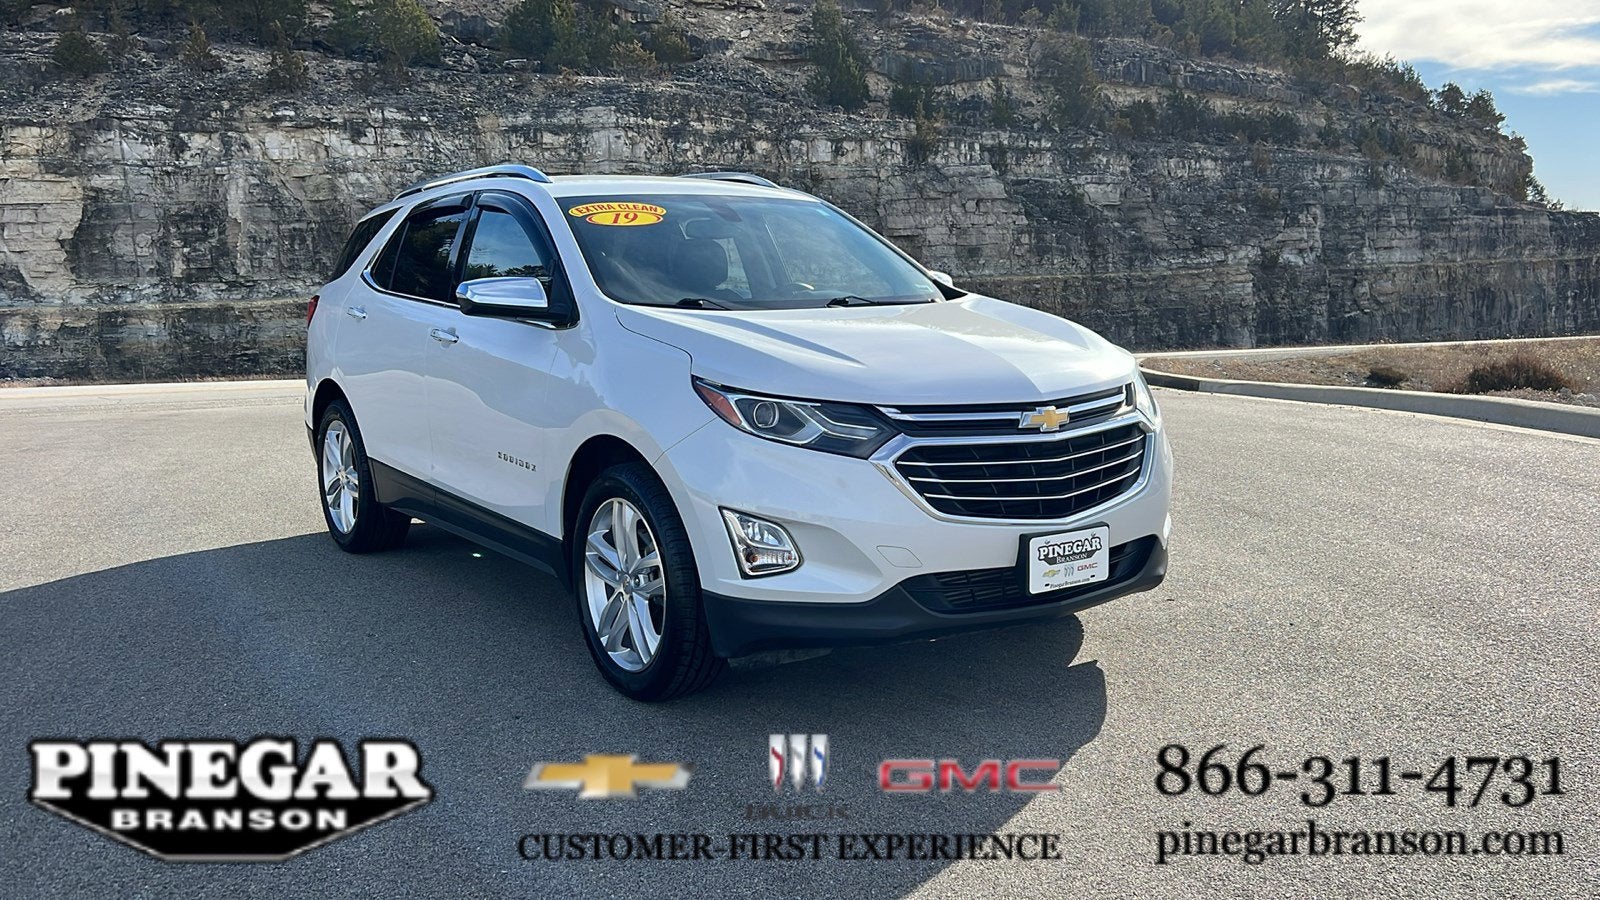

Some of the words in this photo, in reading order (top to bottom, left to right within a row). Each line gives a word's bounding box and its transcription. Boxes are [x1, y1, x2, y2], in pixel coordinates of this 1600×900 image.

[575, 203, 616, 215] EXTRA
[617, 203, 659, 213] CLEAN
[612, 212, 639, 224] 19
[1038, 537, 1102, 560] PINEGAR
[1077, 562, 1098, 571] GMC
